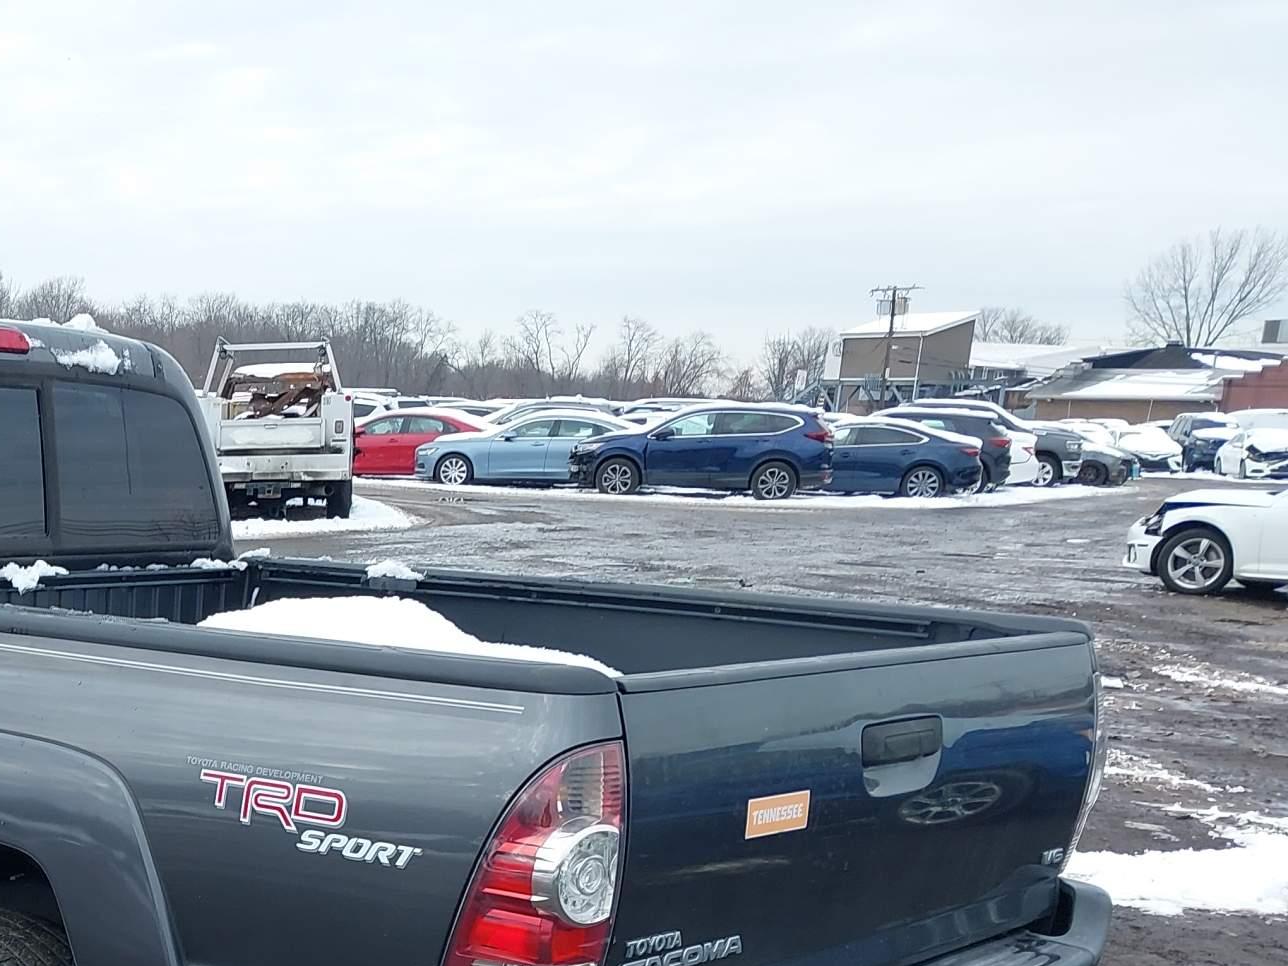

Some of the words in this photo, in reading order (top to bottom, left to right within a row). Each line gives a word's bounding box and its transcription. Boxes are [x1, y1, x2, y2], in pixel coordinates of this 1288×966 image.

[187, 756, 218, 768] TOYOTA
[220, 761, 253, 774] RACING
[255, 767, 323, 784] DEVELOPMENT
[200, 769, 348, 835] TRD
[752, 803, 804, 825] TENNESSEE
[296, 830, 424, 870] SPORT
[1041, 847, 1064, 865] V6
[625, 931, 682, 959] TOYOTA
